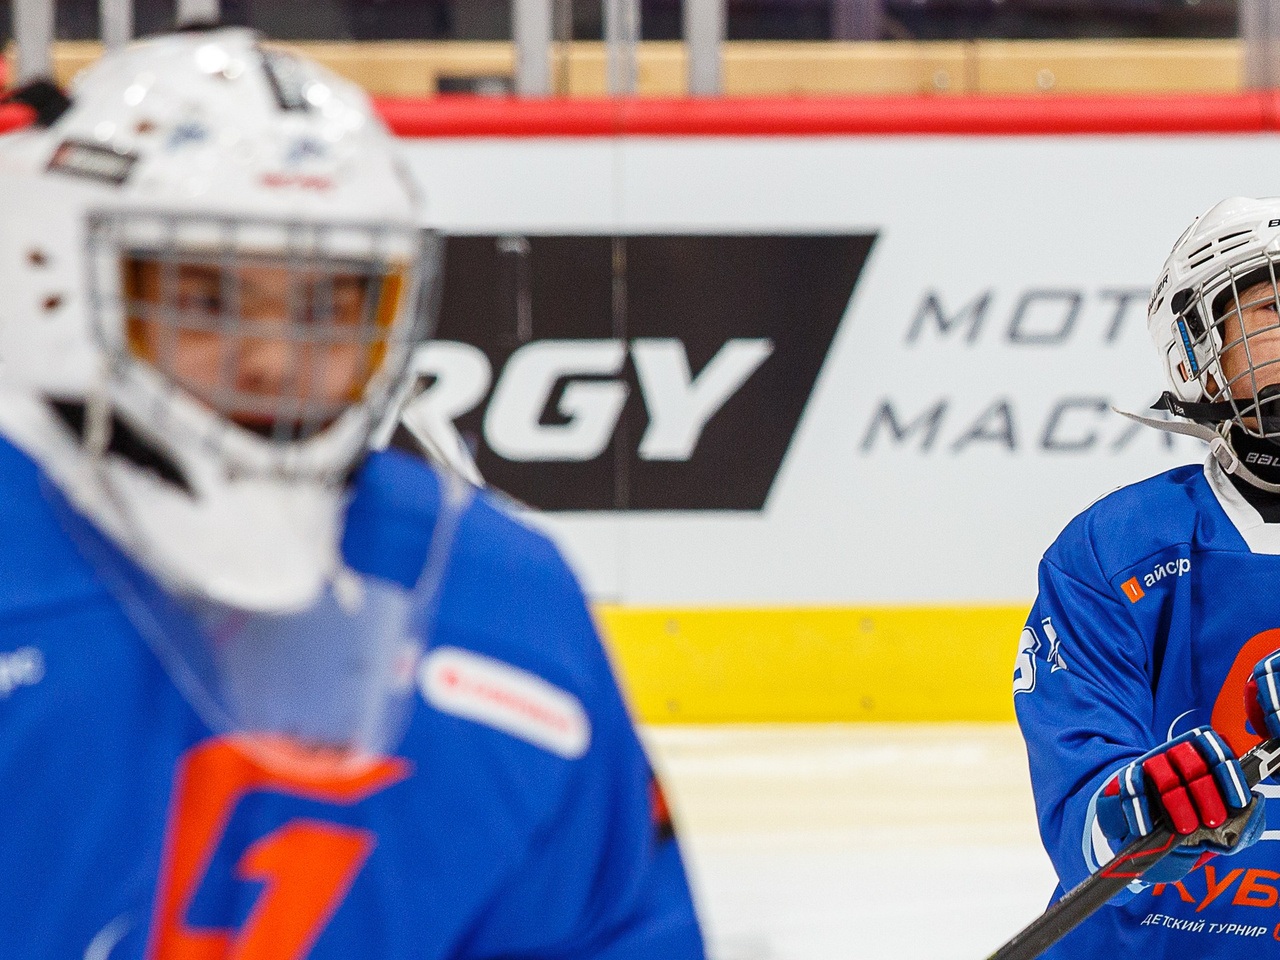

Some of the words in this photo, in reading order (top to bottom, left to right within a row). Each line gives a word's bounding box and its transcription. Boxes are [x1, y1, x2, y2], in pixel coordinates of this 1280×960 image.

[860, 396, 1210, 453] МАСЛ
[1141, 913, 1205, 933] ДЕТСКИЙ
[1208, 922, 1268, 938] ТУРНИР
